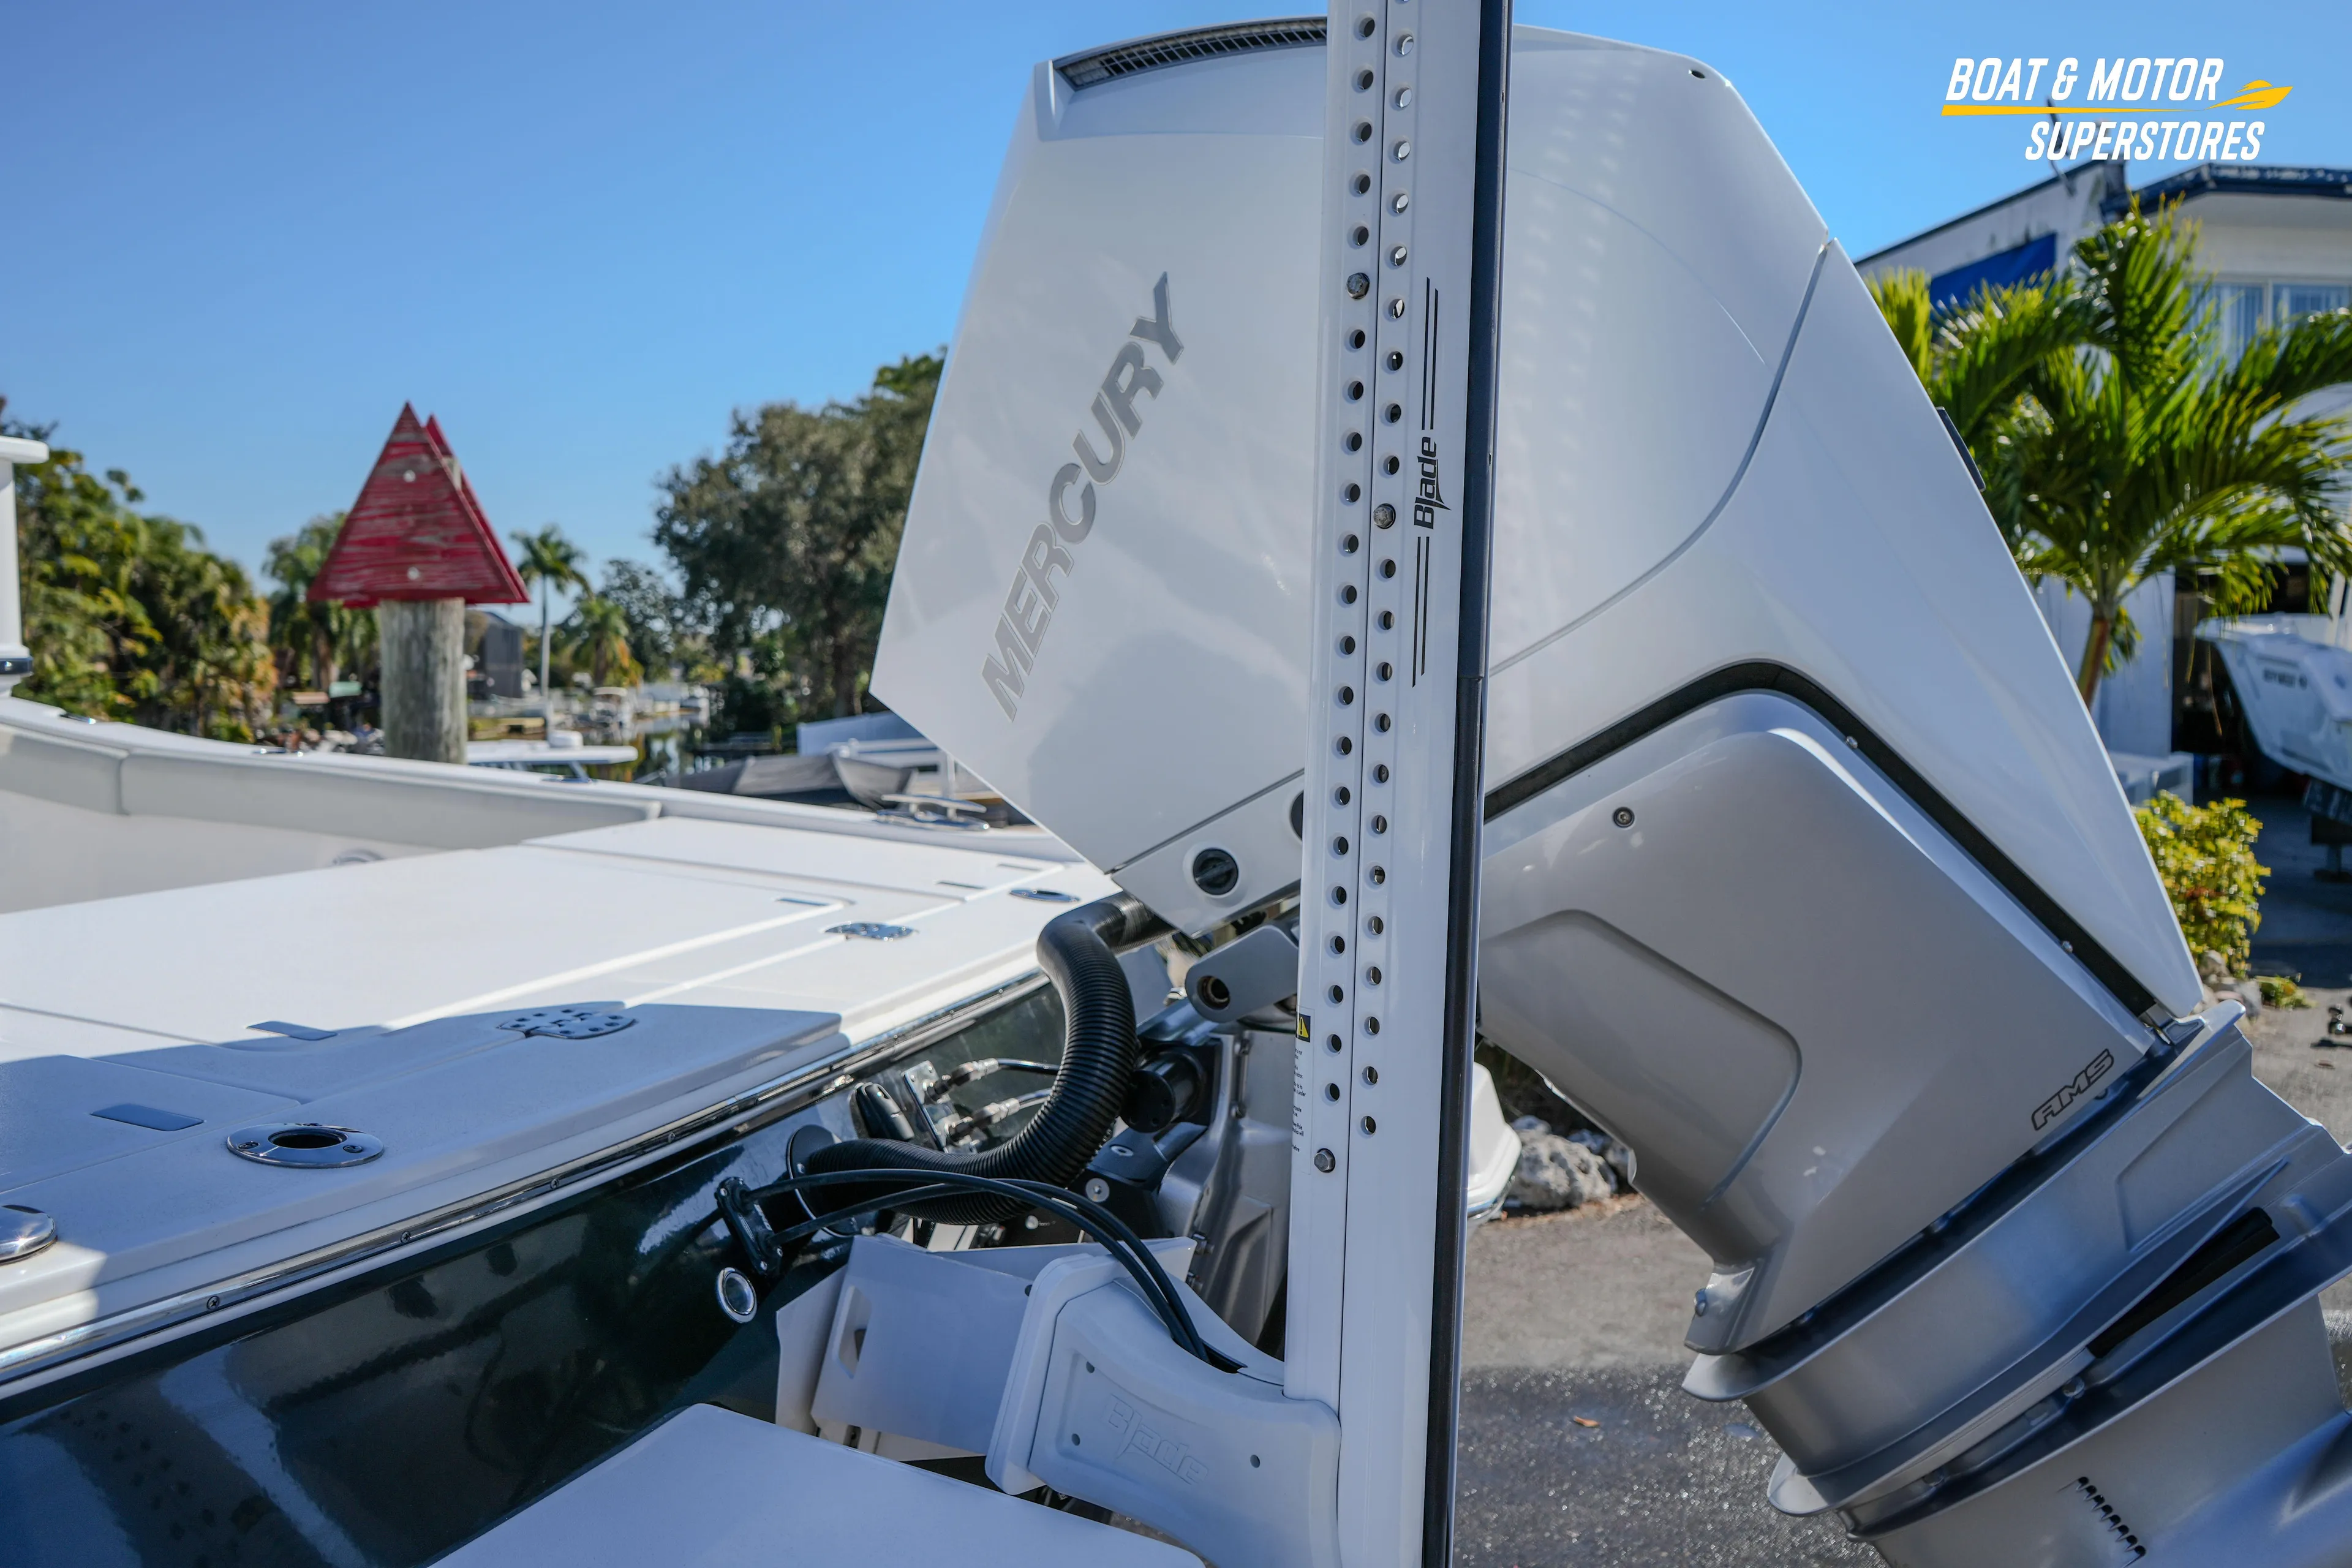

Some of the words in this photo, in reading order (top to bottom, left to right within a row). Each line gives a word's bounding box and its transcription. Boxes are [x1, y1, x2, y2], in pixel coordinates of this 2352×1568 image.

[981, 271, 1184, 723] MERCURY
[1414, 436, 1452, 530] Blade
[2031, 1048, 2114, 1131] AMS
[1107, 1392, 1210, 1486] Blade
